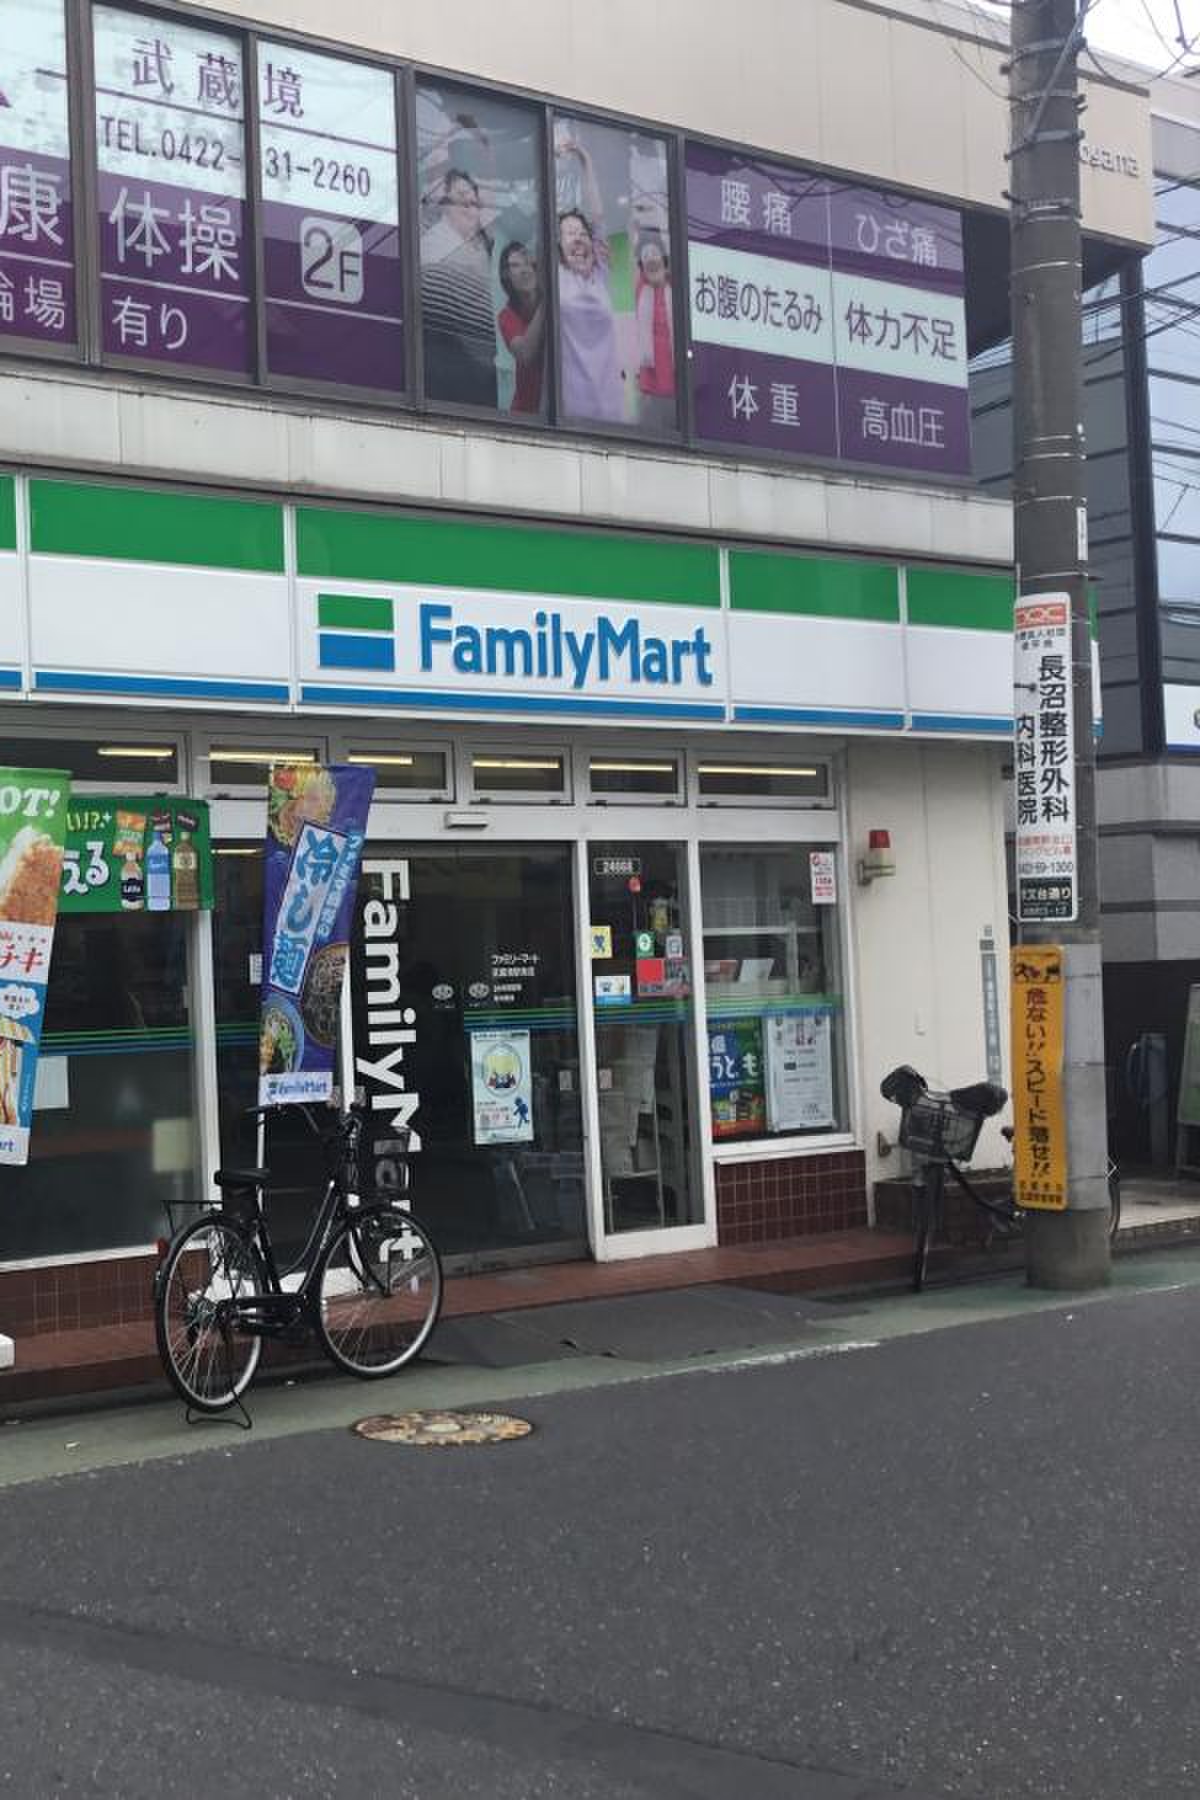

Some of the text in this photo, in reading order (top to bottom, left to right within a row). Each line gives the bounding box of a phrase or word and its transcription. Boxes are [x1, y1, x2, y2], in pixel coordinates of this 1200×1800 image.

[131, 38, 305, 118] 武蔵境
[109, 187, 240, 281] 体操
[720, 178, 792, 236] 腰痛
[302, 226, 361, 293] 2F
[855, 212, 939, 268] ひざ痛
[111, 296, 188, 350] 有り
[694, 271, 823, 335] お腹のたるみ
[845, 301, 958, 362] 体力不足
[727, 374, 801, 427] 体重
[859, 397, 946, 449] 高血圧
[419, 601, 712, 690] FamilyMart
[1016, 714, 1038, 825] 内科医院
[1039, 654, 1070, 823] 長沼整形外科
